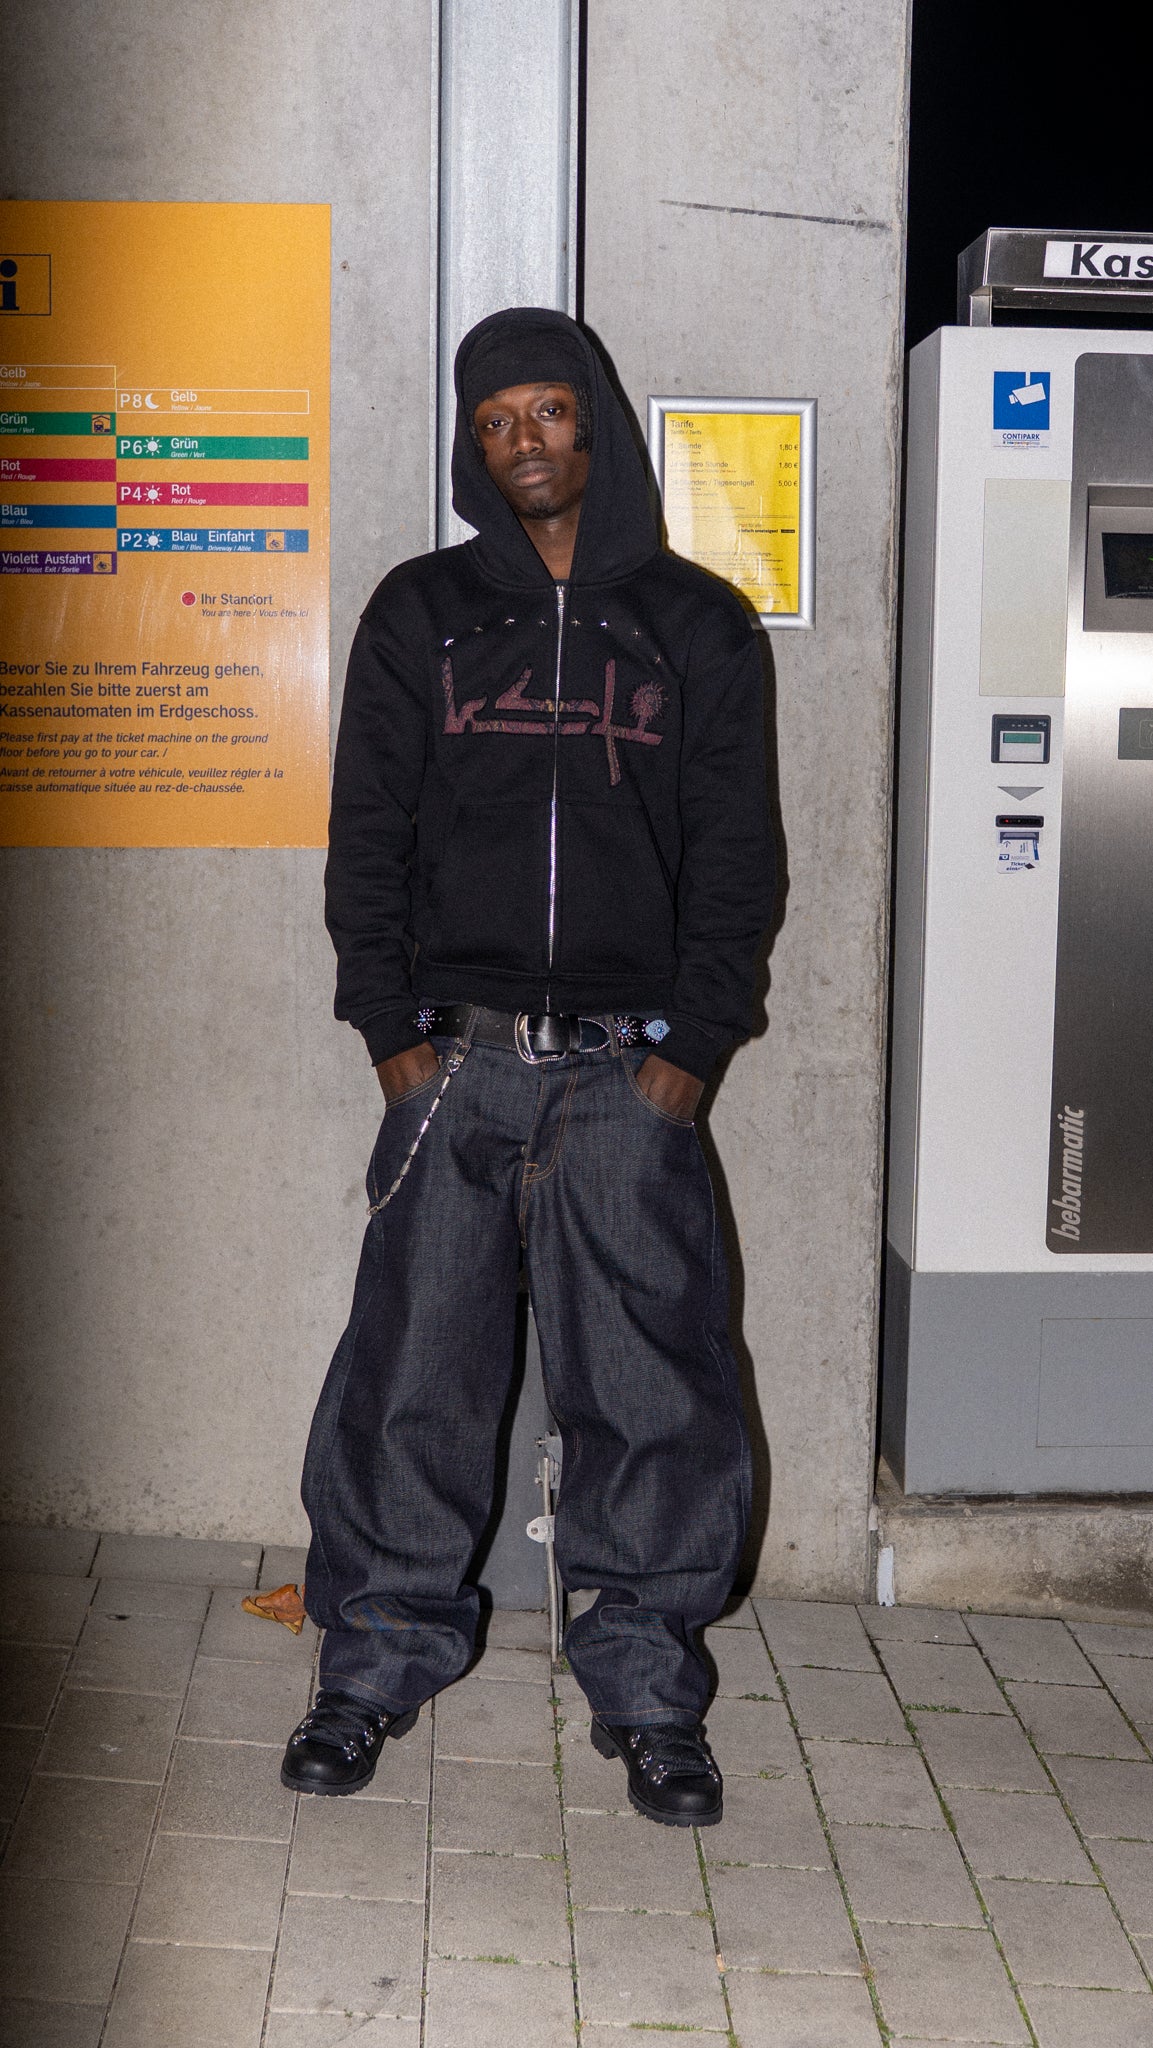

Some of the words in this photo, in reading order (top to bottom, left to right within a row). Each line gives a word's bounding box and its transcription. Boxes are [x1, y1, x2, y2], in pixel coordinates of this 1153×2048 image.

[1071, 244, 1153, 278] Kas
[0, 367, 26, 378] Gelb
[170, 391, 198, 402] Gelb
[0, 413, 28, 425] Grün
[671, 420, 694, 428] Tarife
[170, 437, 198, 449] Grün
[1, 460, 21, 471] Rot
[171, 484, 191, 495] Rot
[2, 505, 27, 516] Blau
[171, 531, 197, 542] Blau
[208, 531, 255, 542] Einfahrt
[2, 553, 39, 564] Violett
[45, 553, 91, 565] Ausfahrt
[201, 593, 217, 605] Ihr
[221, 593, 273, 605] Standort
[0, 662, 40, 675] Bevor
[45, 662, 68, 675] Sie
[72, 664, 90, 675] zu
[95, 662, 137, 675] Ihrem
[142, 662, 210, 679] Fahrzeug
[215, 663, 264, 679] gehen,
[0, 683, 66, 697] bezahlen
[71, 683, 94, 697] Sie
[98, 683, 131, 697] bitte
[136, 684, 182, 697] zuerst
[186, 686, 209, 697] am
[0, 704, 132, 718] Kassenautomaten
[137, 704, 154, 718] im
[160, 704, 259, 721] Erdgeschoss.
[0, 732, 34, 743] Please
[37, 732, 58, 743] first
[60, 733, 80, 744] pay
[82, 733, 93, 743] at
[96, 733, 113, 743] the
[116, 733, 144, 743] ticket
[147, 733, 192, 743] machine
[195, 735, 208, 743] on
[211, 733, 228, 743] the
[231, 733, 269, 745] ground
[26, 747, 60, 758] before
[62, 749, 82, 760] you
[84, 749, 98, 760] go
[101, 748, 112, 758] to
[114, 749, 138, 760] your
[140, 748, 159, 758] car.
[0, 767, 29, 777] Avant
[32, 768, 45, 777] de
[48, 768, 97, 777] retourner
[100, 767, 106, 777] à
[109, 768, 135, 777] votre
[138, 768, 184, 779] véhicule,
[188, 768, 227, 778] veuillez
[230, 768, 261, 780] régler
[264, 768, 271, 778] à
[273, 768, 284, 778] la
[0, 782, 33, 793] caisse
[36, 782, 101, 794] automatique
[104, 782, 136, 793] située
[139, 784, 152, 793] au
[155, 783, 245, 793] rez-de-chaussée.
[1051, 1105, 1084, 1241] bebarmatic
